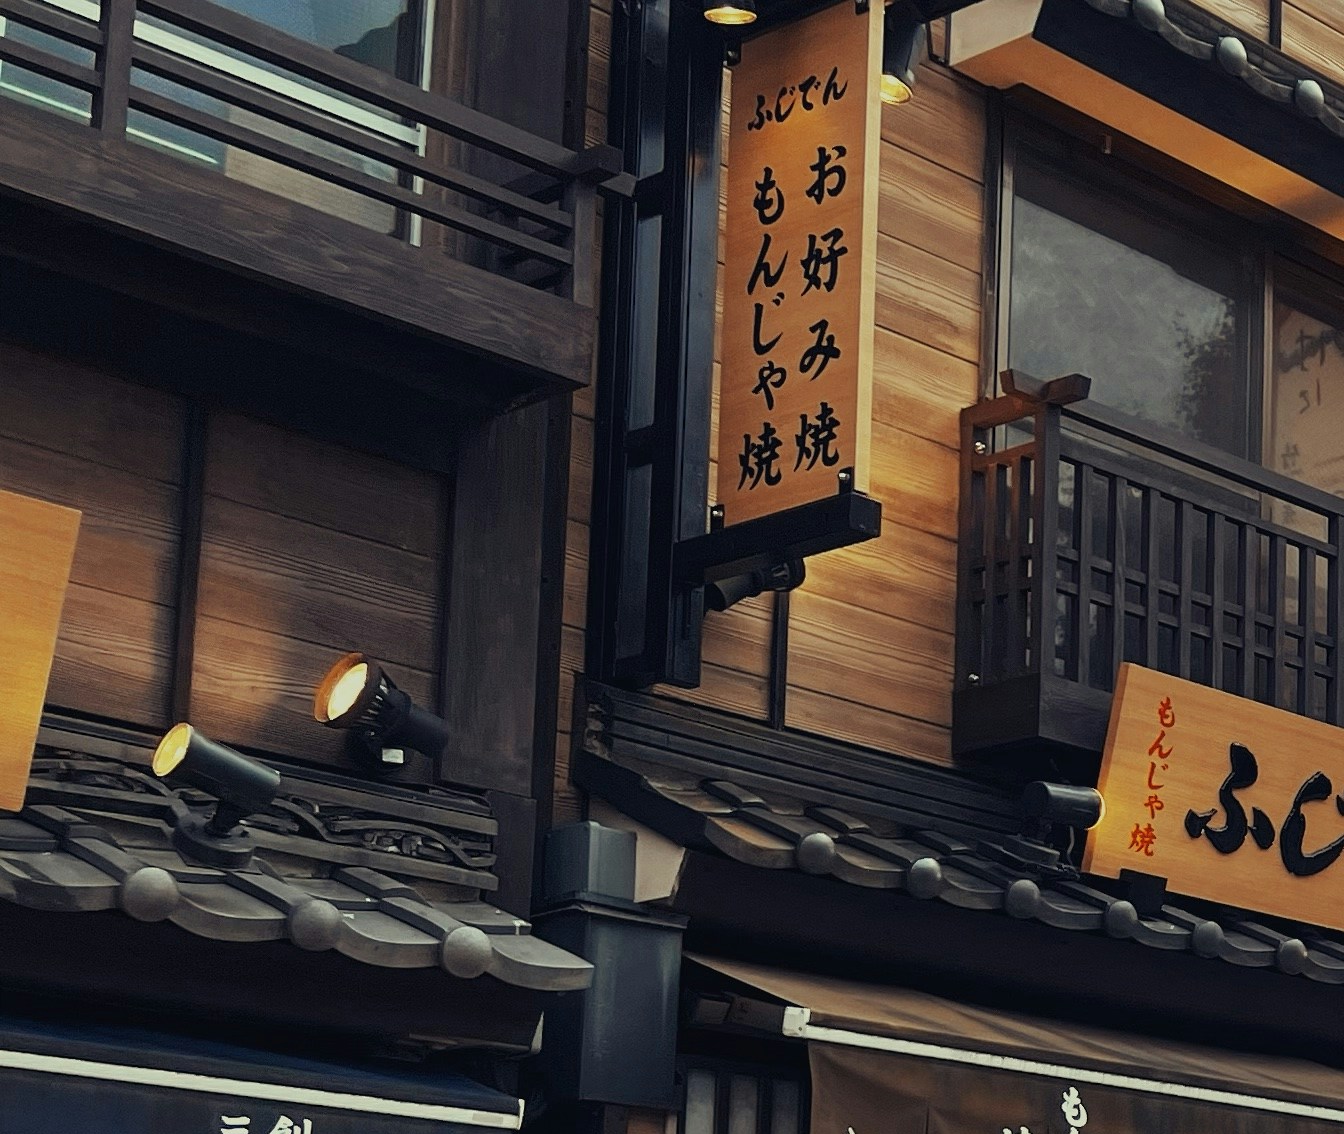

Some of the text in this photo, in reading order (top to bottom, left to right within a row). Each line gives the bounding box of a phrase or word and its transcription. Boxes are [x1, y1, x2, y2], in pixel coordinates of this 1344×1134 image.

[747, 67, 848, 134] ふじでん
[737, 167, 786, 492] もんじゃ焼
[793, 144, 849, 473] お好み焼
[1127, 696, 1175, 857] もんじゃ焼
